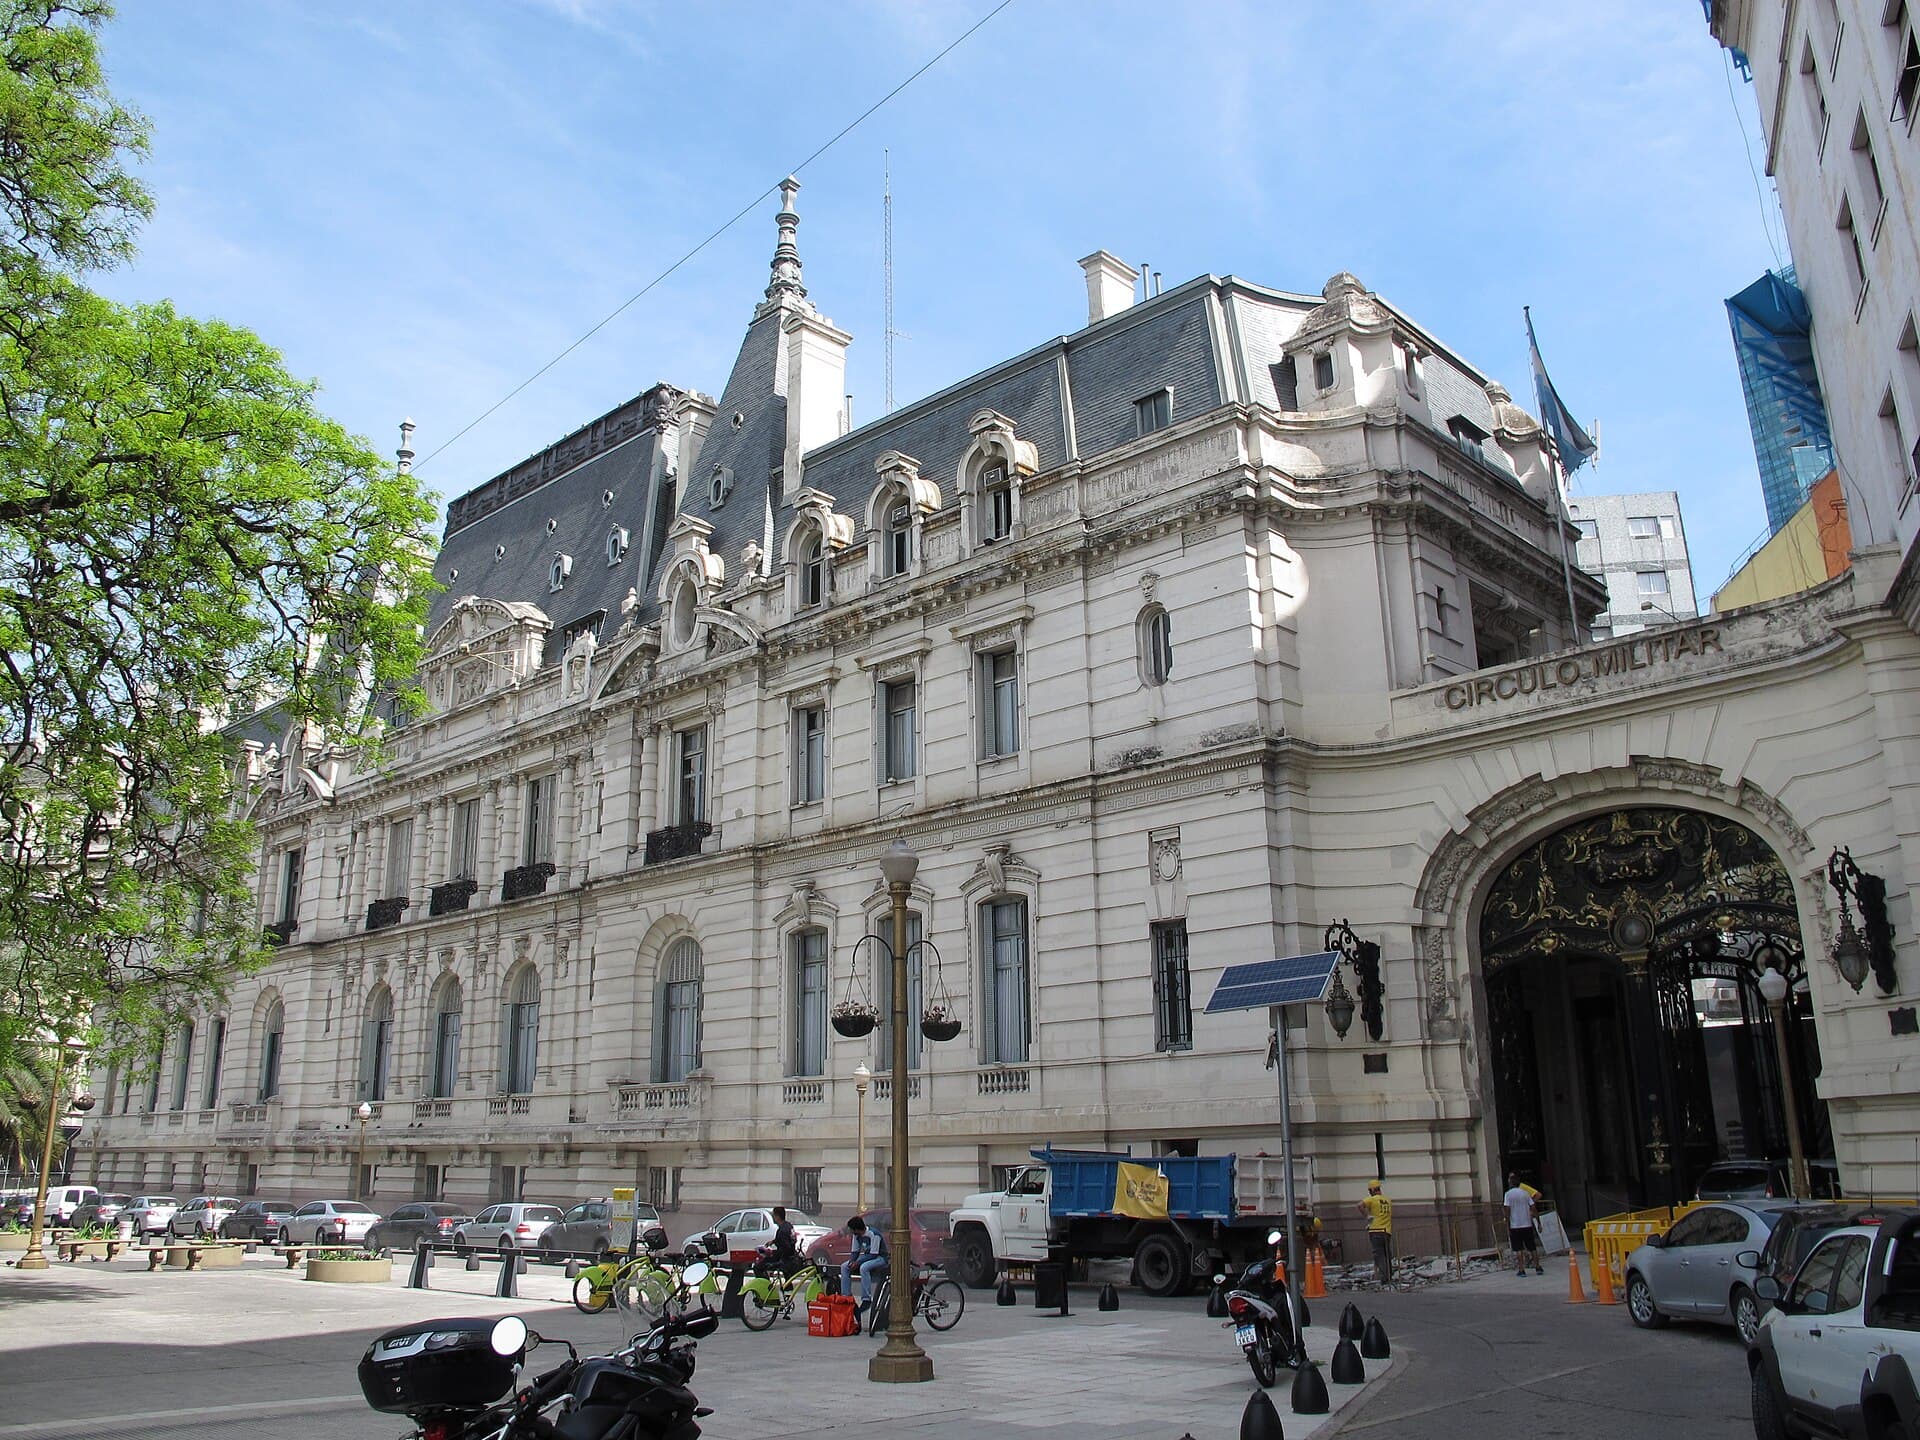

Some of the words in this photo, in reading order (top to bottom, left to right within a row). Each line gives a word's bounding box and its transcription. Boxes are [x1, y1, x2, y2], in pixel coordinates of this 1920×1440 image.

[1444, 659, 1580, 710] CIRCULO
[1592, 628, 1723, 679] MILITAR
[388, 1337, 410, 1348] GIVI
